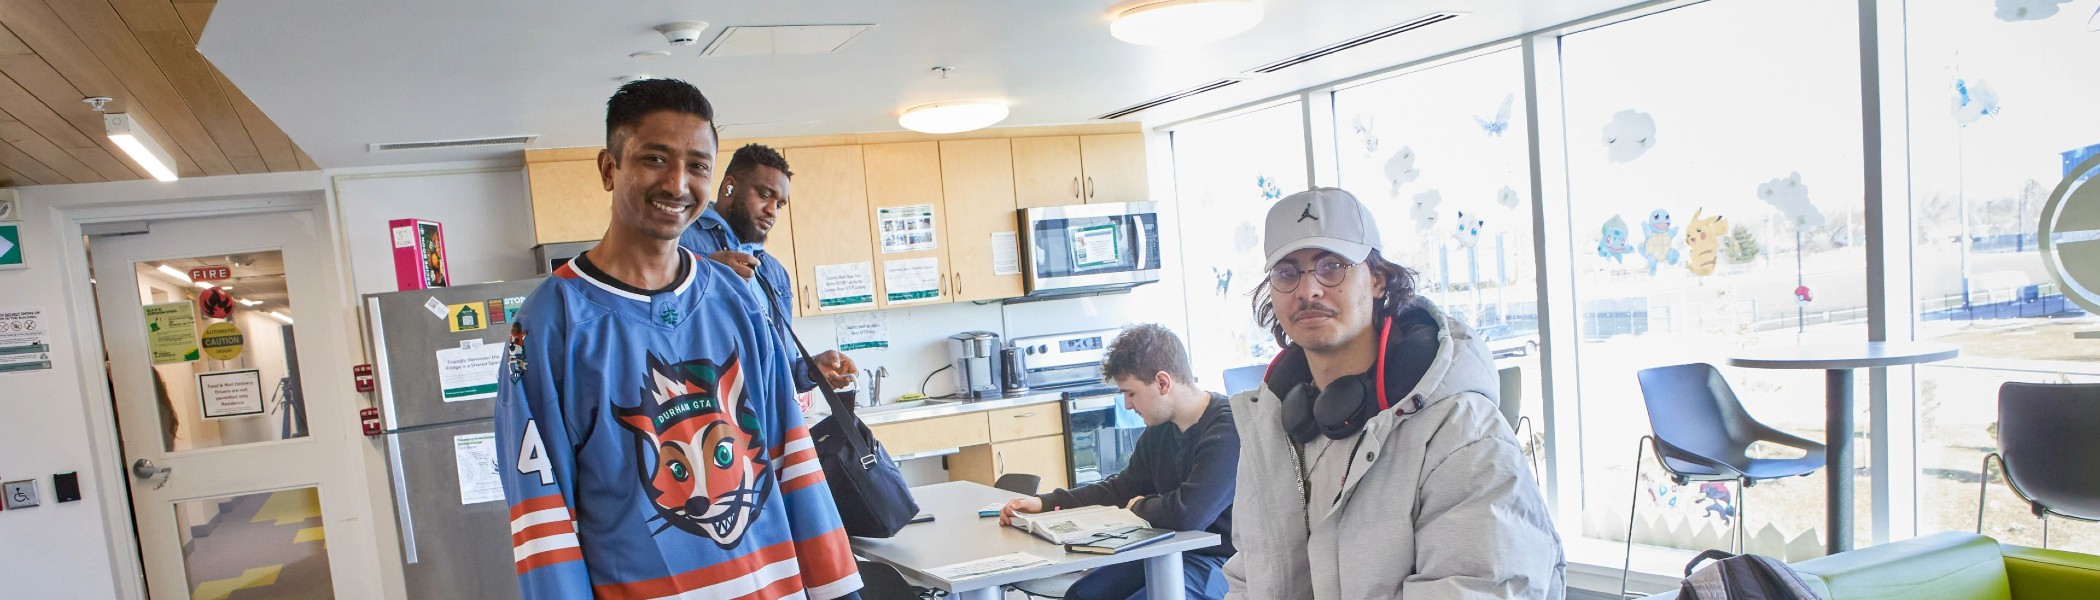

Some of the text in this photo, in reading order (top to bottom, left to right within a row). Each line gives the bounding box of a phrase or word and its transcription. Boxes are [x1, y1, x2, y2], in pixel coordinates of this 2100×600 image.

[193, 269, 227, 279] FIRE
[504, 296, 526, 305] STOP
[206, 336, 240, 346] CAUTION
[658, 400, 712, 424] DURHAM GTA
[517, 418, 556, 486] 4
